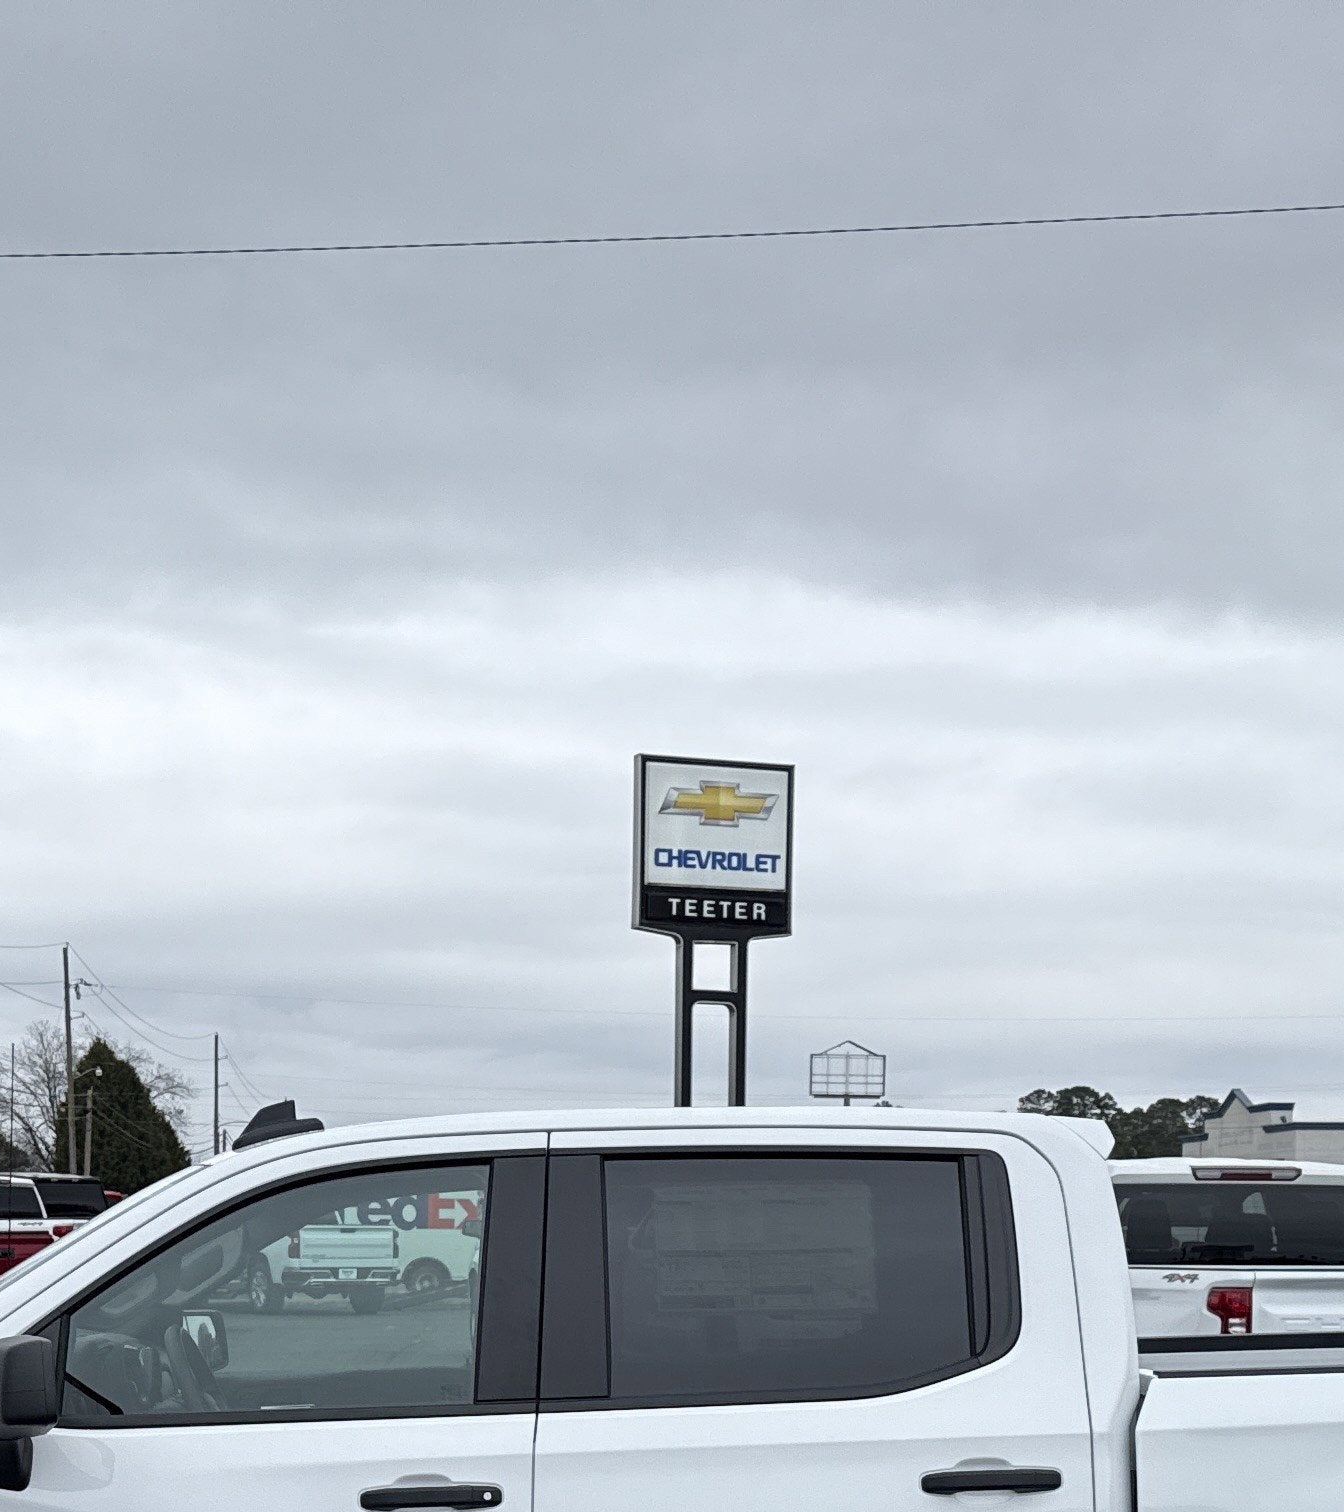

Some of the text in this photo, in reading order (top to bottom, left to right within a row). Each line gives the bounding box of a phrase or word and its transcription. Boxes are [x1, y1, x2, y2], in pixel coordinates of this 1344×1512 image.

[654, 848, 781, 873] CHEVROLET
[668, 898, 766, 921] TEETER
[357, 1193, 482, 1231] edEx
